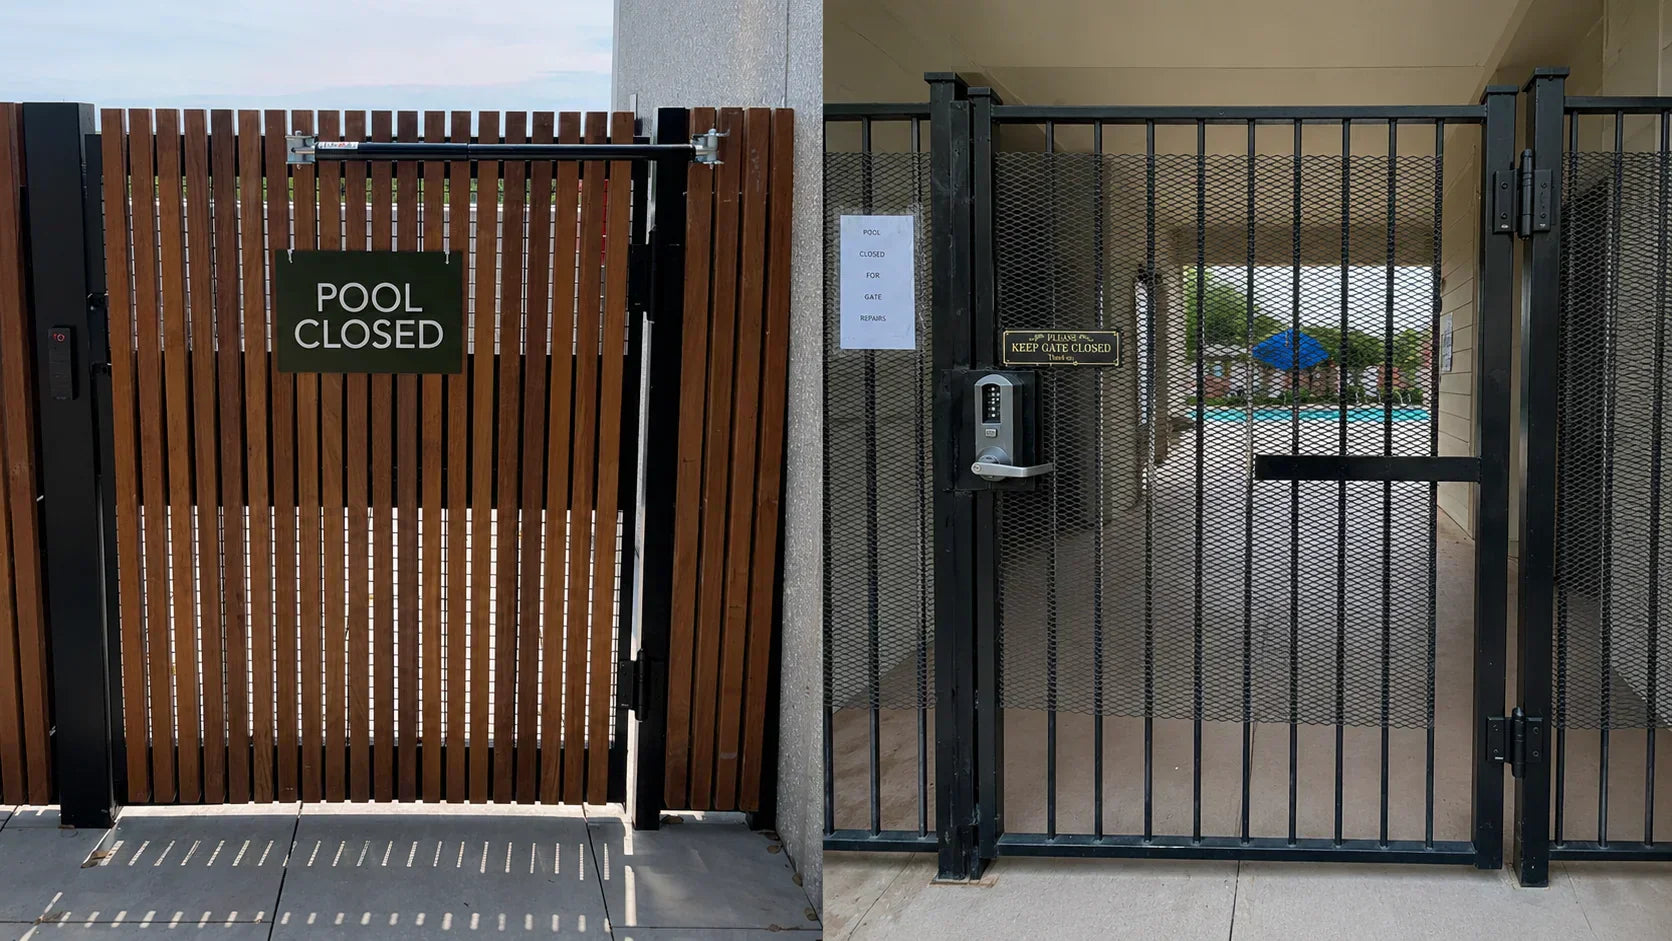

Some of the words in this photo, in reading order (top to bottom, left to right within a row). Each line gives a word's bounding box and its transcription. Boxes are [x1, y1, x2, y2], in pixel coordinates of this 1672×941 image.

[859, 250, 885, 258] CLOSED
[317, 282, 423, 313] POOL
[294, 318, 444, 349] CLOSED
[1012, 343, 1039, 353] KEEP
[1041, 343, 1069, 353] GATE
[1071, 343, 1111, 353] CLOSED
